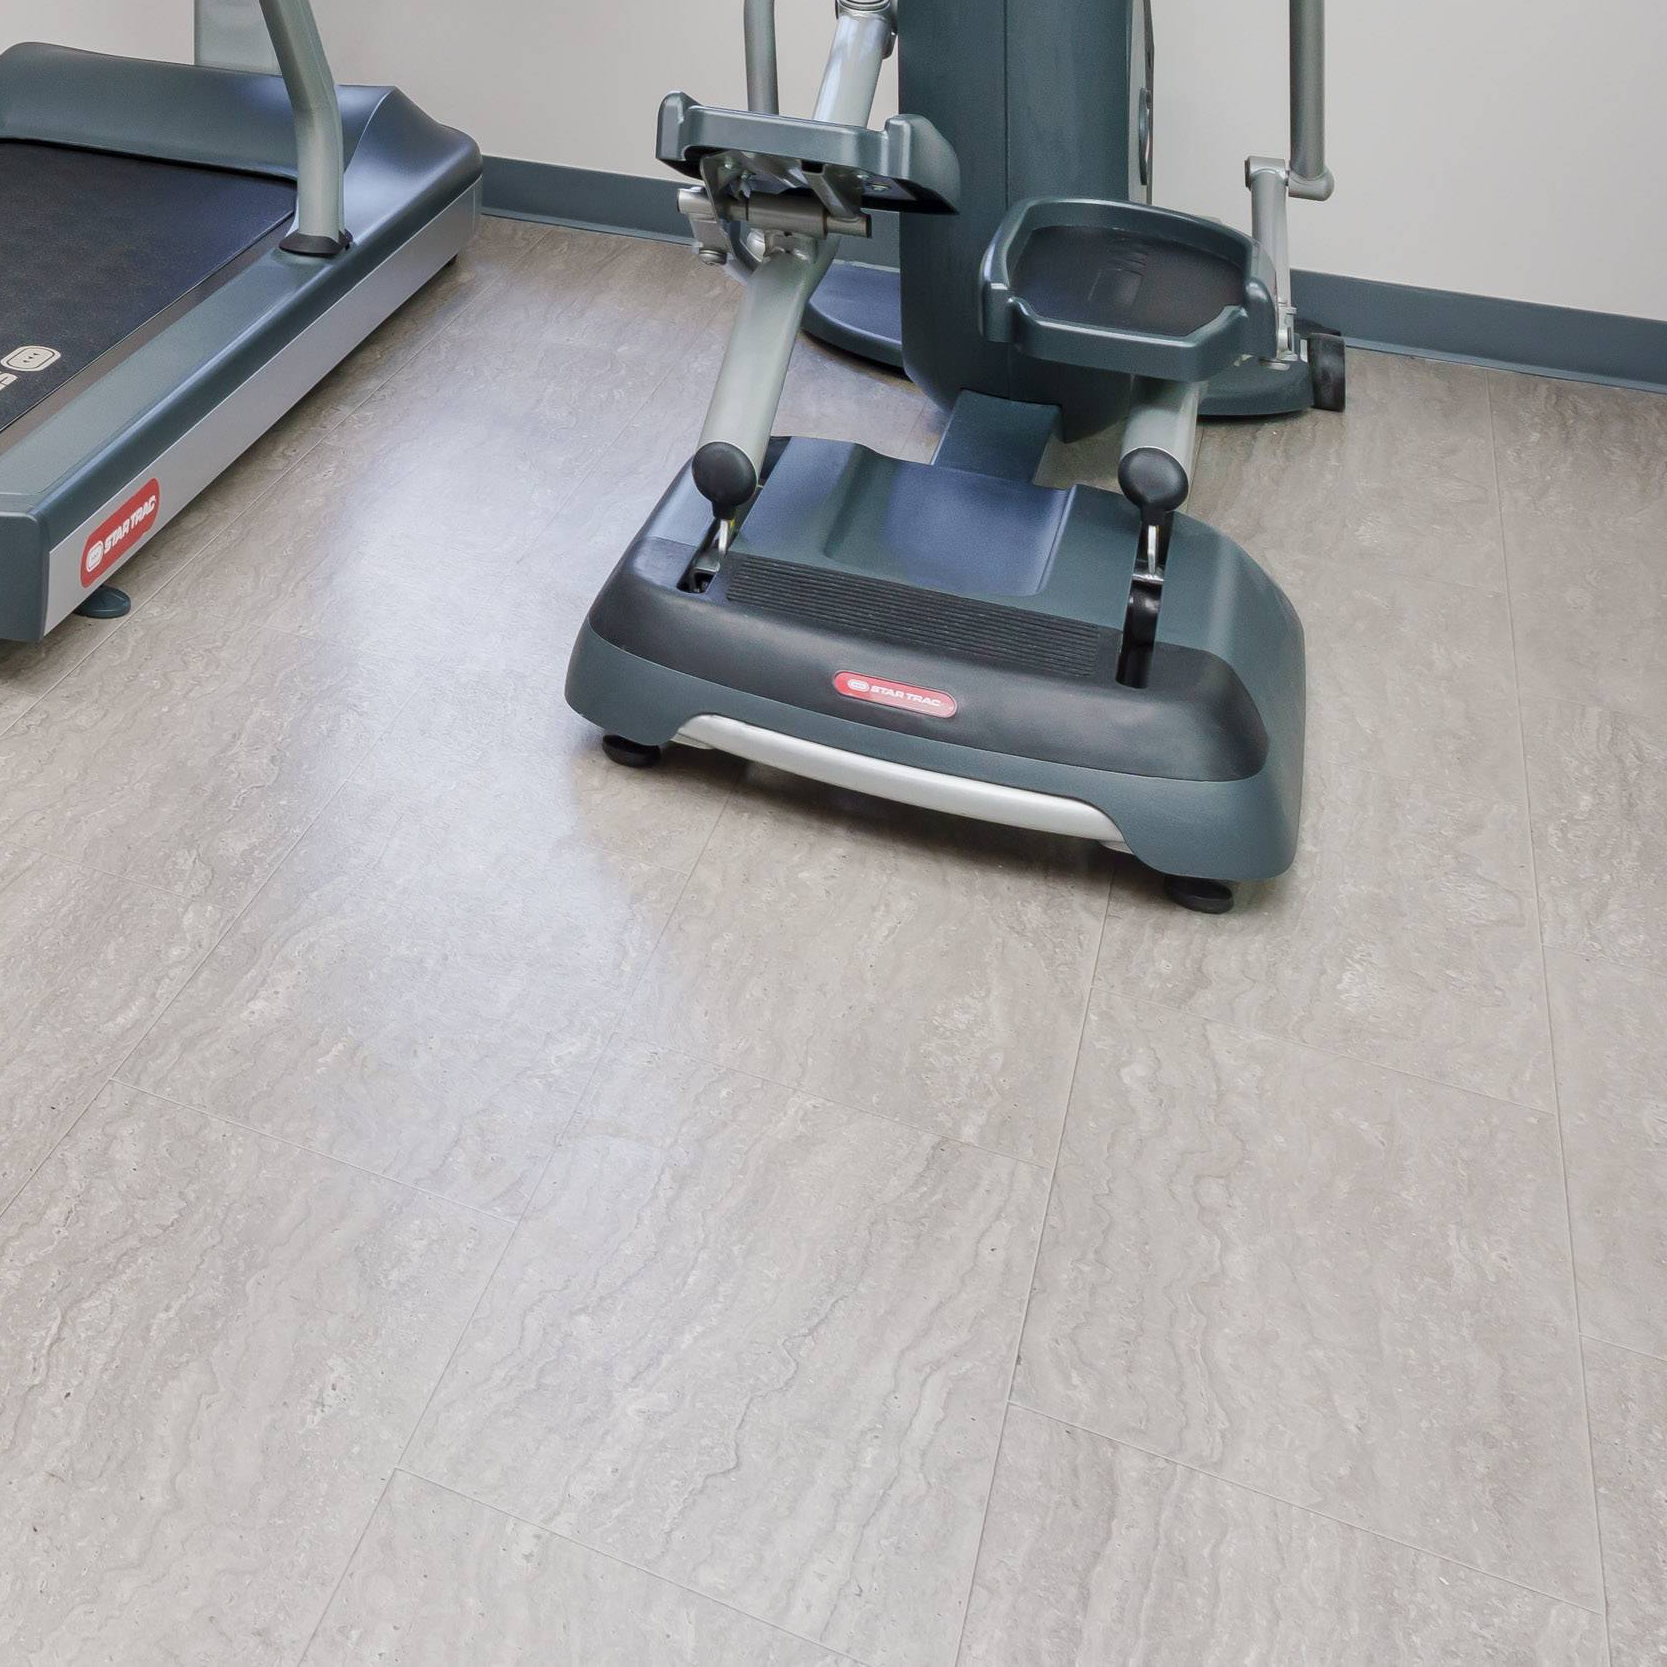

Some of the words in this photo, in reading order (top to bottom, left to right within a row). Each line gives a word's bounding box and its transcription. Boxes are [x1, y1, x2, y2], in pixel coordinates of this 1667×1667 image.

[104, 519, 130, 554] STAR
[130, 495, 157, 529] TRAC
[870, 685, 904, 699] STAR
[906, 693, 941, 707] TRAC
